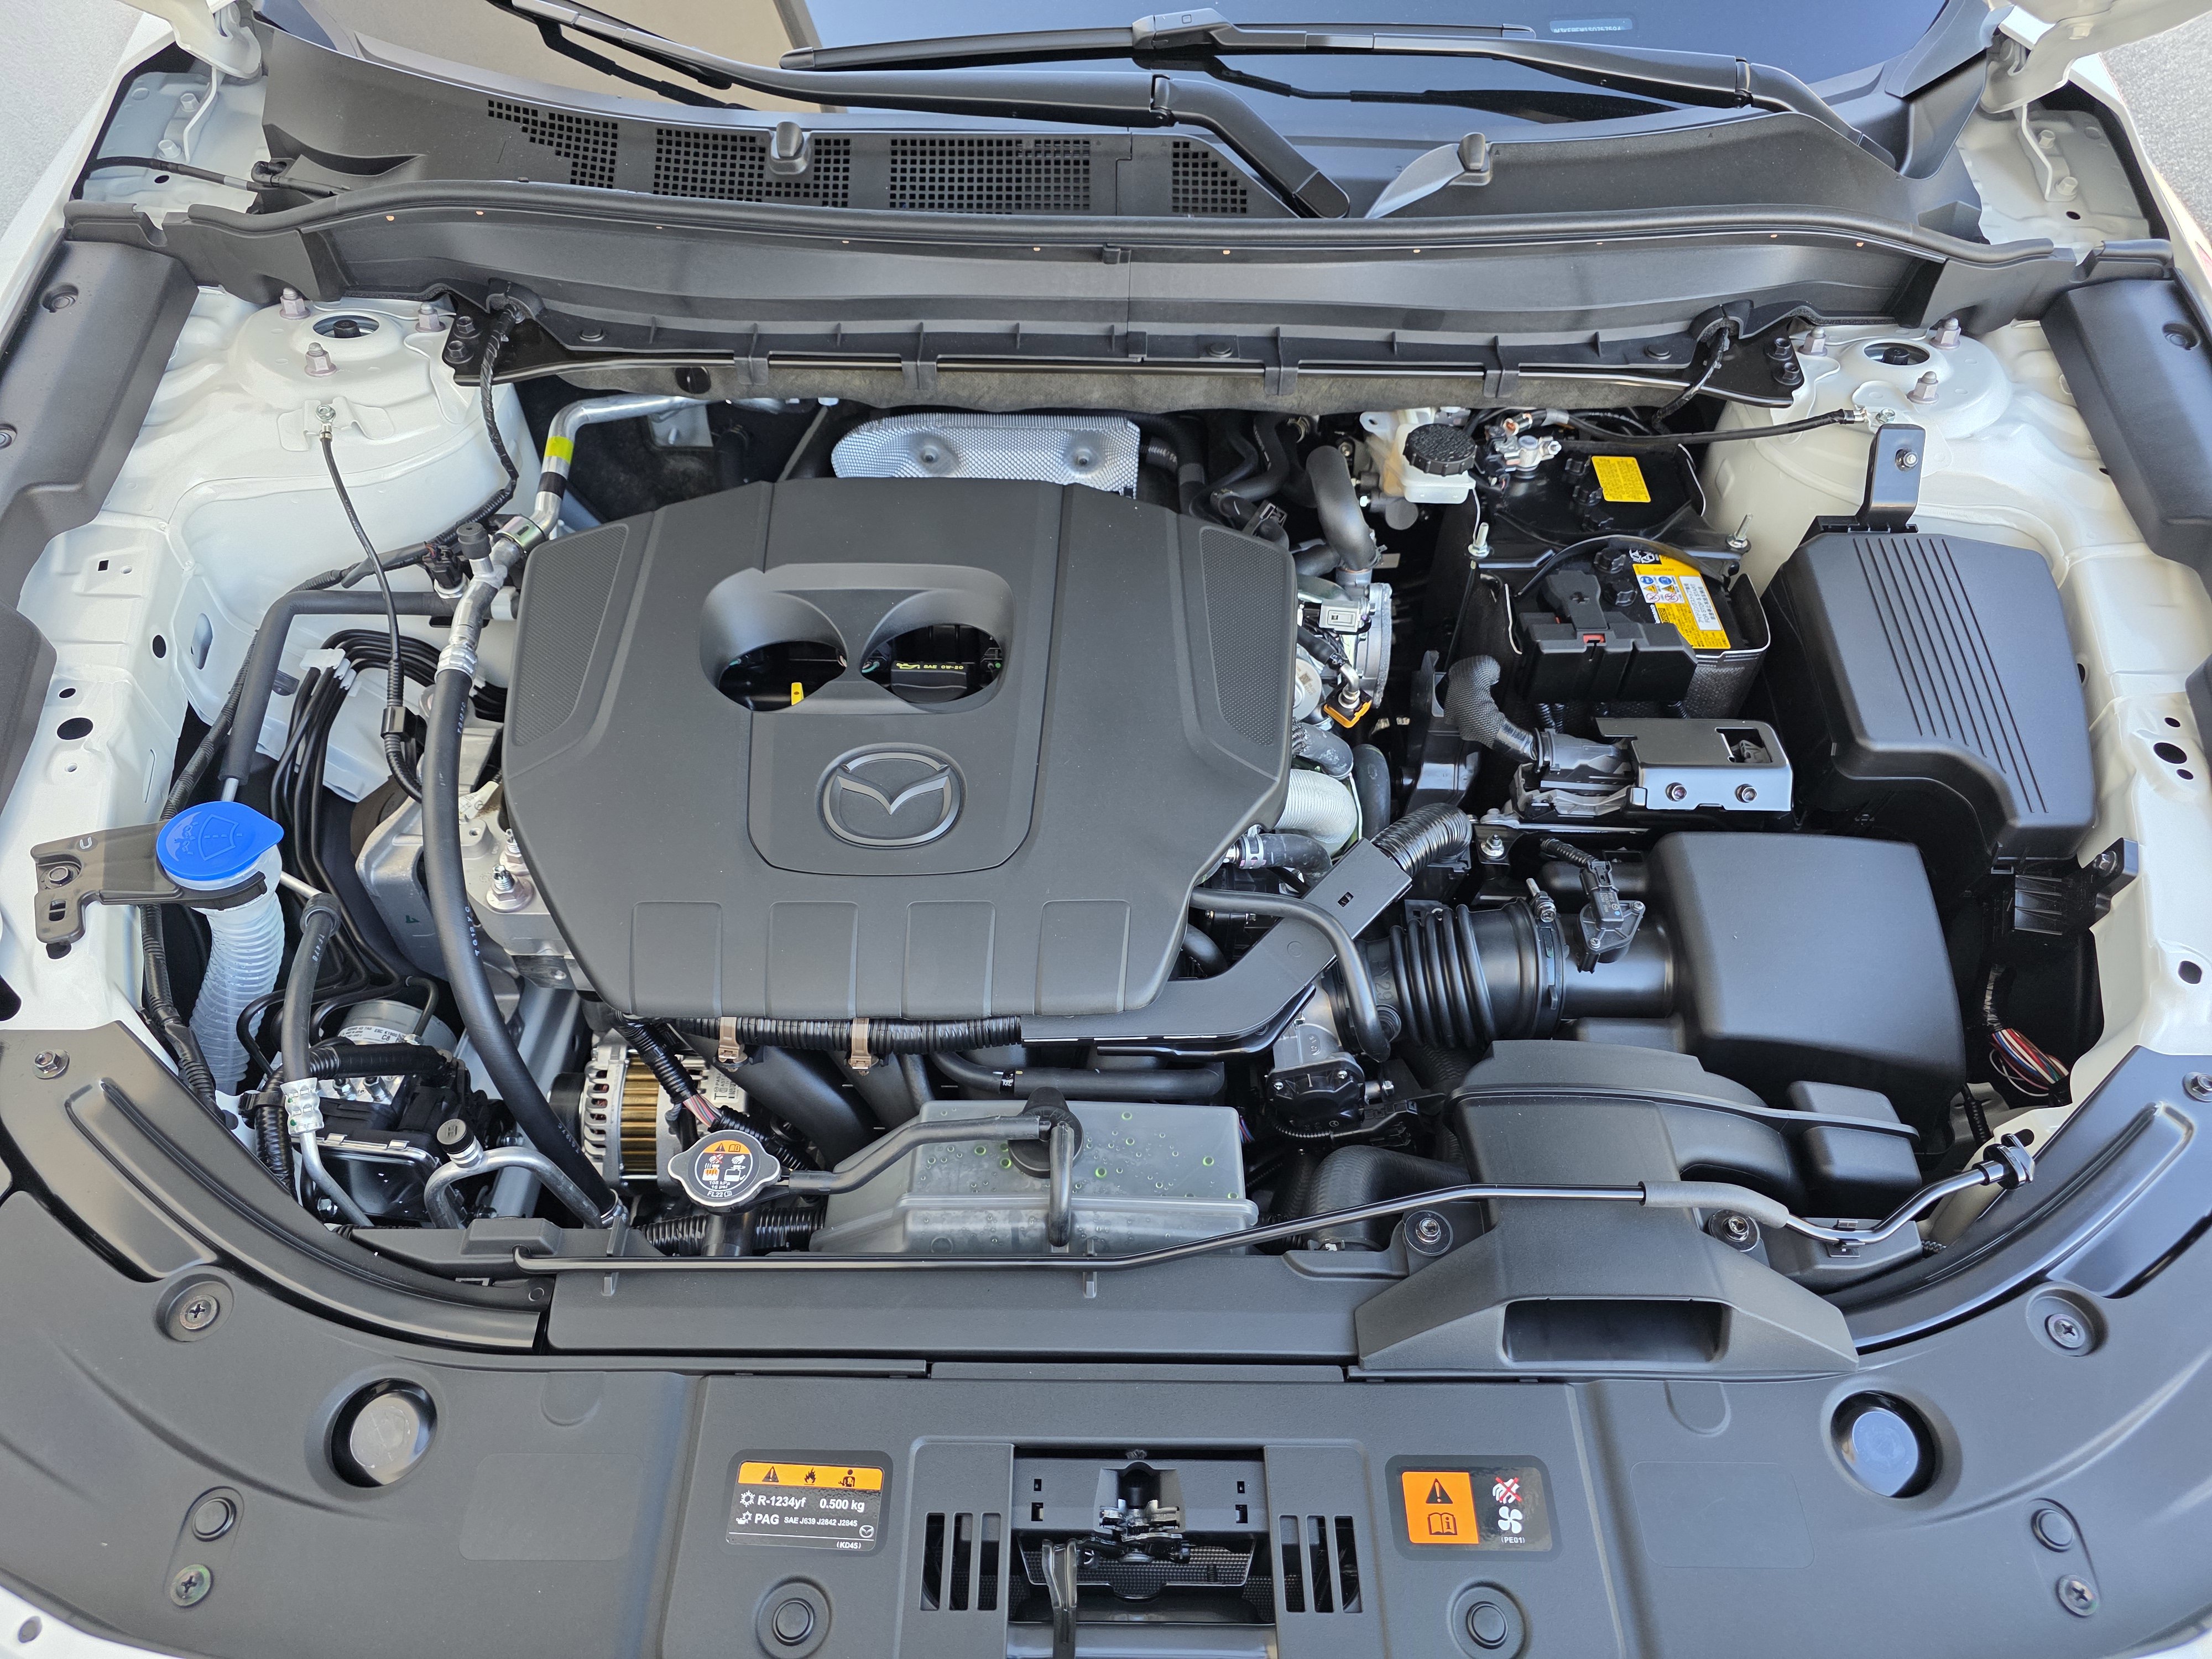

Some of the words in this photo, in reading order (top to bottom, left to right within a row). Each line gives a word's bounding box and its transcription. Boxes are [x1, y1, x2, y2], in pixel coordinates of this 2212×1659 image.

[1690, 584, 1700, 597] START
[1698, 602, 1706, 613] STOP
[757, 1495, 807, 1510] R-1234yf
[820, 1498, 848, 1510] 0.500
[851, 1499, 865, 1513] kg
[754, 1514, 780, 1525] PAG
[800, 1517, 816, 1525] J639
[816, 1518, 837, 1526] J2842
[837, 1519, 858, 1527] J2845
[836, 1541, 862, 1550] (KD45)
